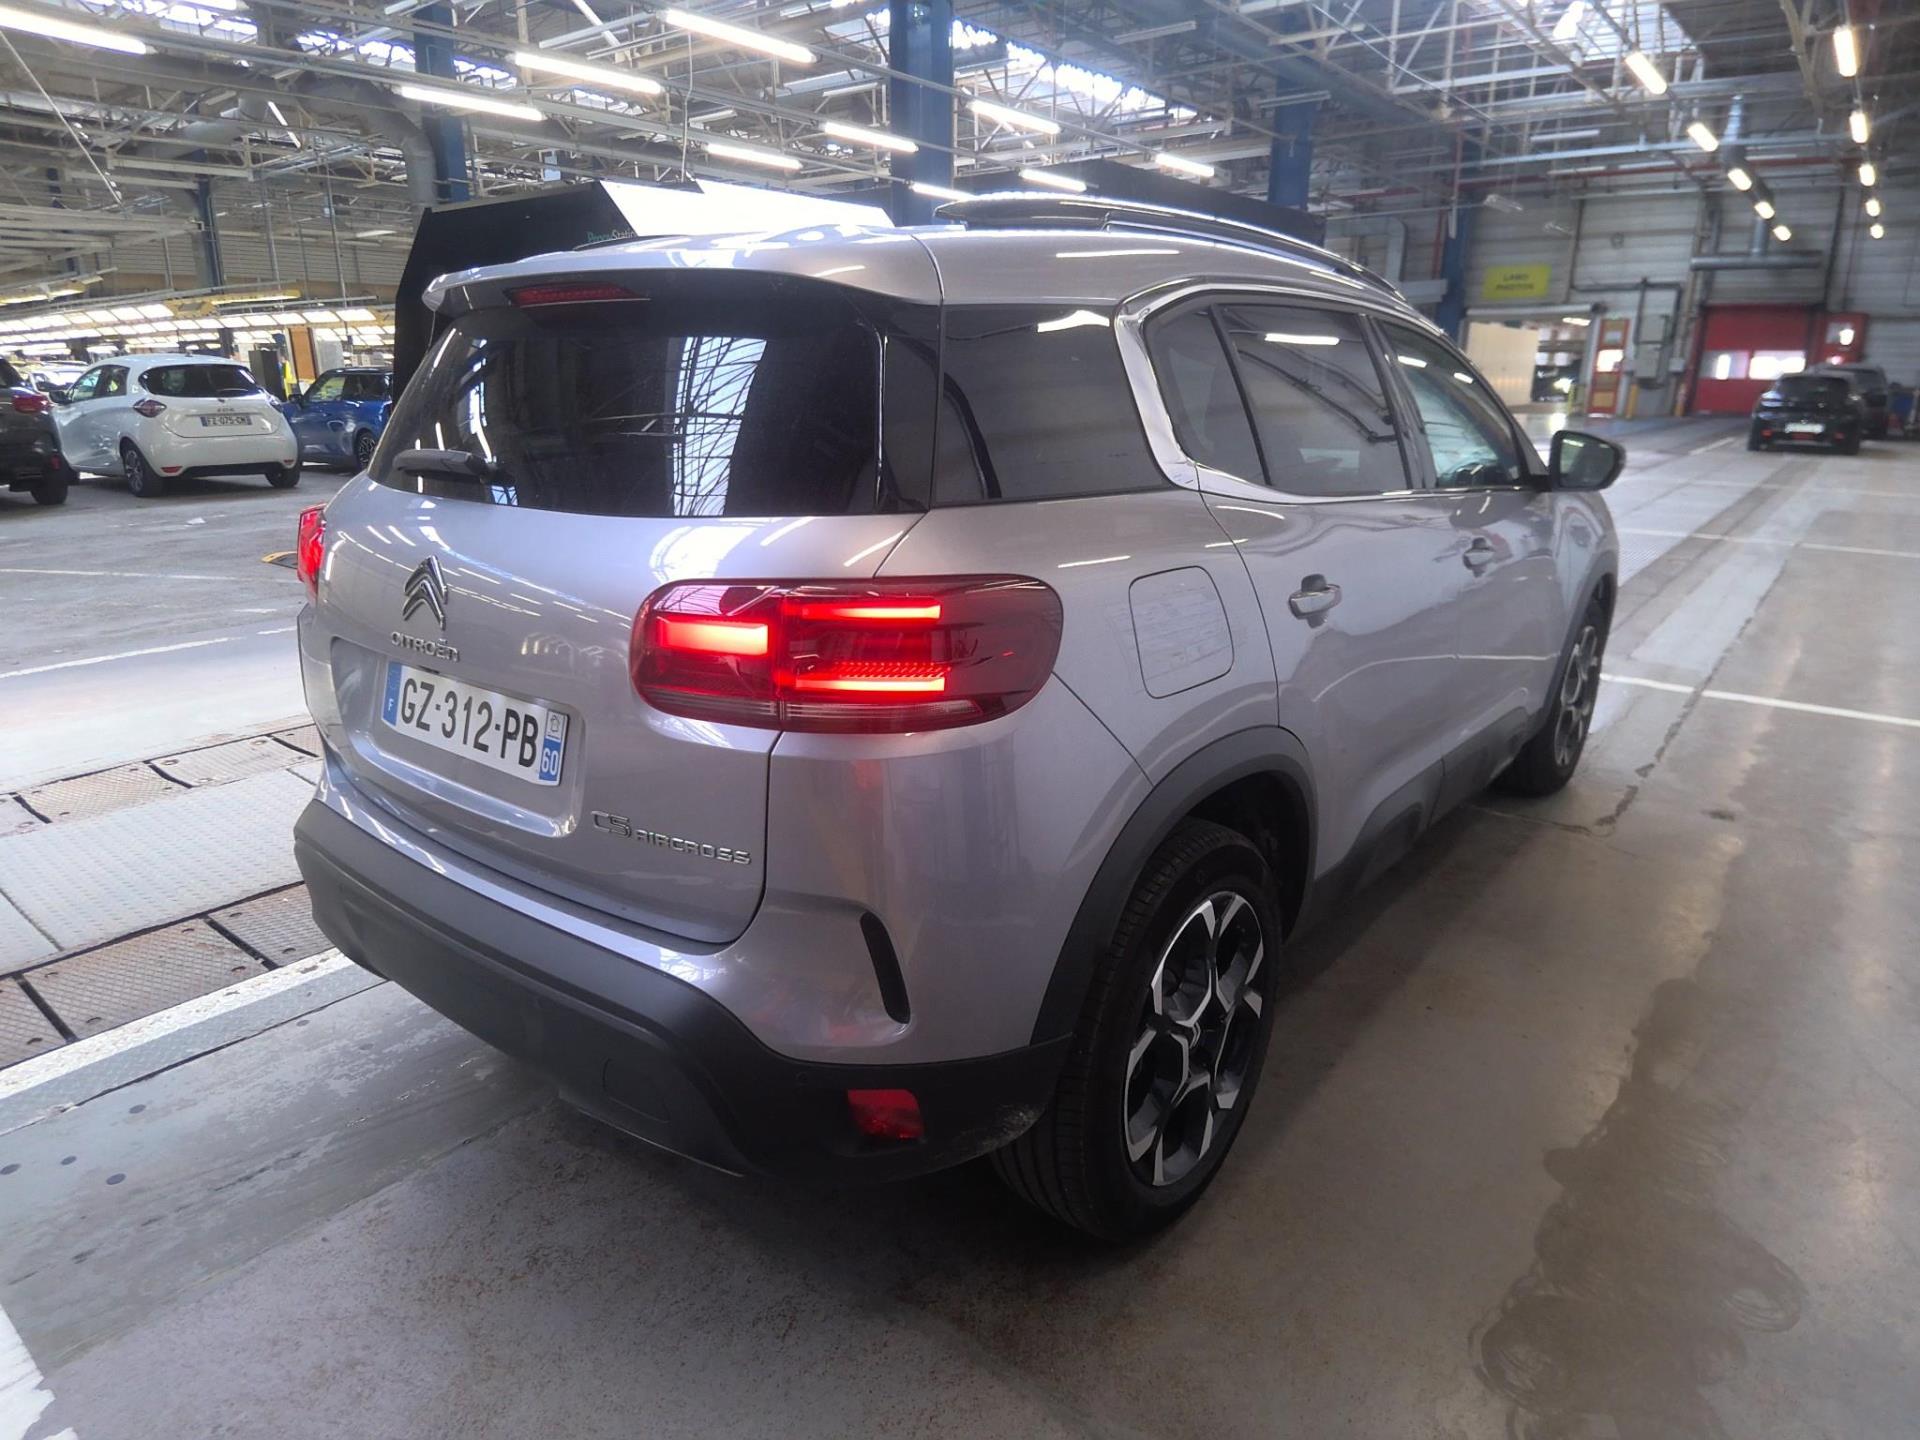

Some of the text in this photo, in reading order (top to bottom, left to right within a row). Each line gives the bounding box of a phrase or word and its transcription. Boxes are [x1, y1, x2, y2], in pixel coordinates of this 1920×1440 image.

[391, 631, 460, 662] CITROËN
[387, 698, 395, 712] F
[401, 677, 539, 768] GZ-312-PB
[541, 748, 560, 774] 60
[591, 810, 752, 865] C5 AIRCROSS
